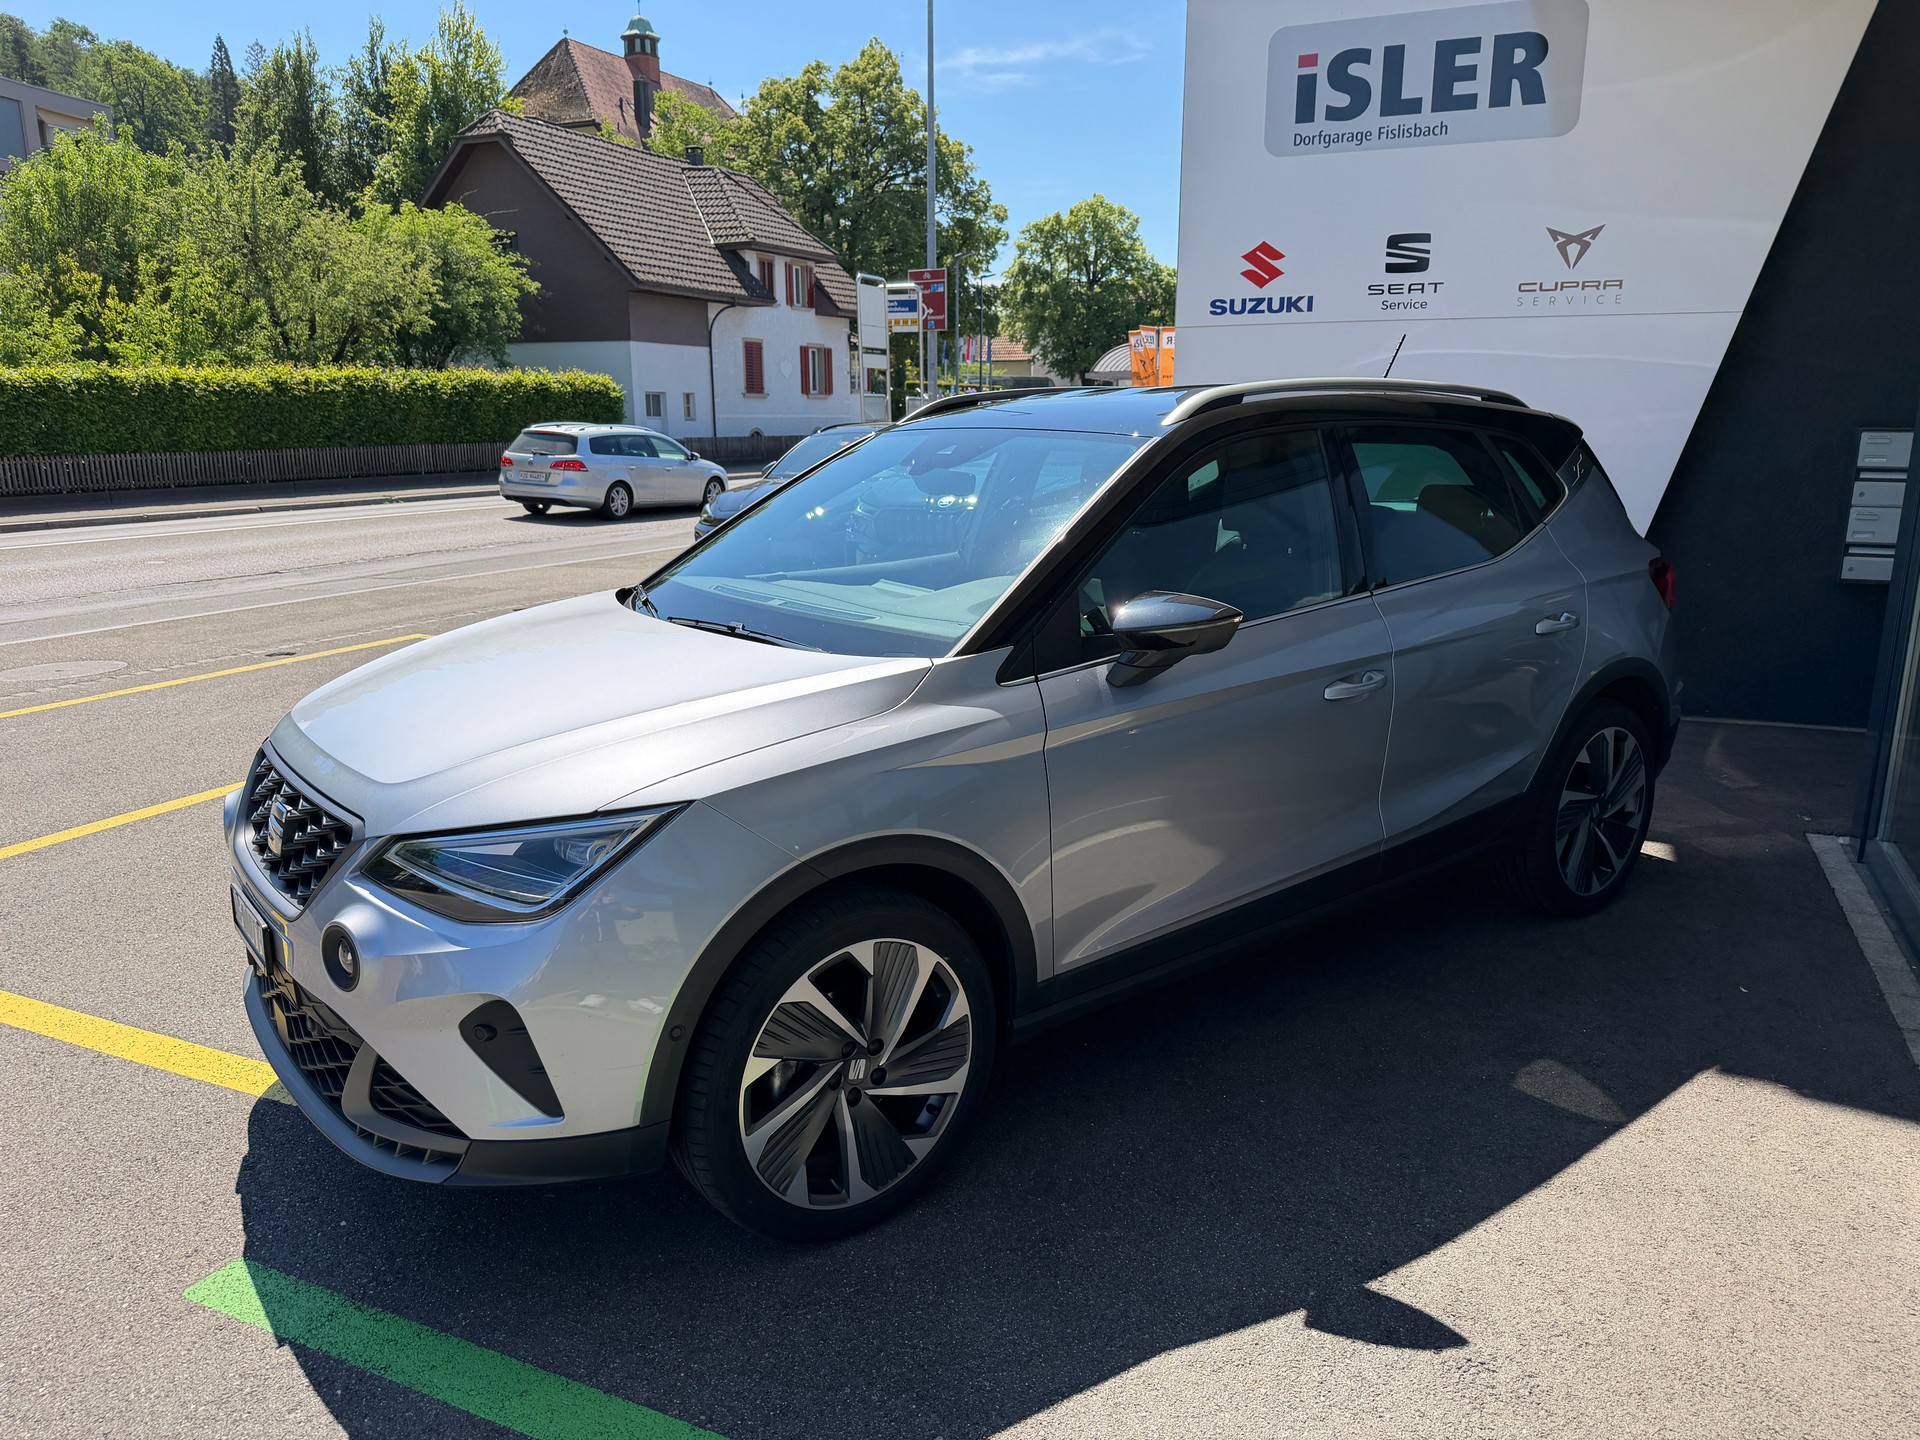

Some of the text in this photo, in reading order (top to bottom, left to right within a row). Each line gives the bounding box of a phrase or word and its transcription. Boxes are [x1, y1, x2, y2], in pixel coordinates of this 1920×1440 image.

[1294, 31, 1550, 125] iSLER
[1293, 121, 1449, 149] Dorfgarage Fislisbach
[1367, 281, 1445, 296] SEAT
[1517, 279, 1624, 293] CUPRA
[1209, 295, 1314, 316] SUZUKI
[1380, 298, 1428, 311] Service
[1516, 294, 1622, 307] SERVICE
